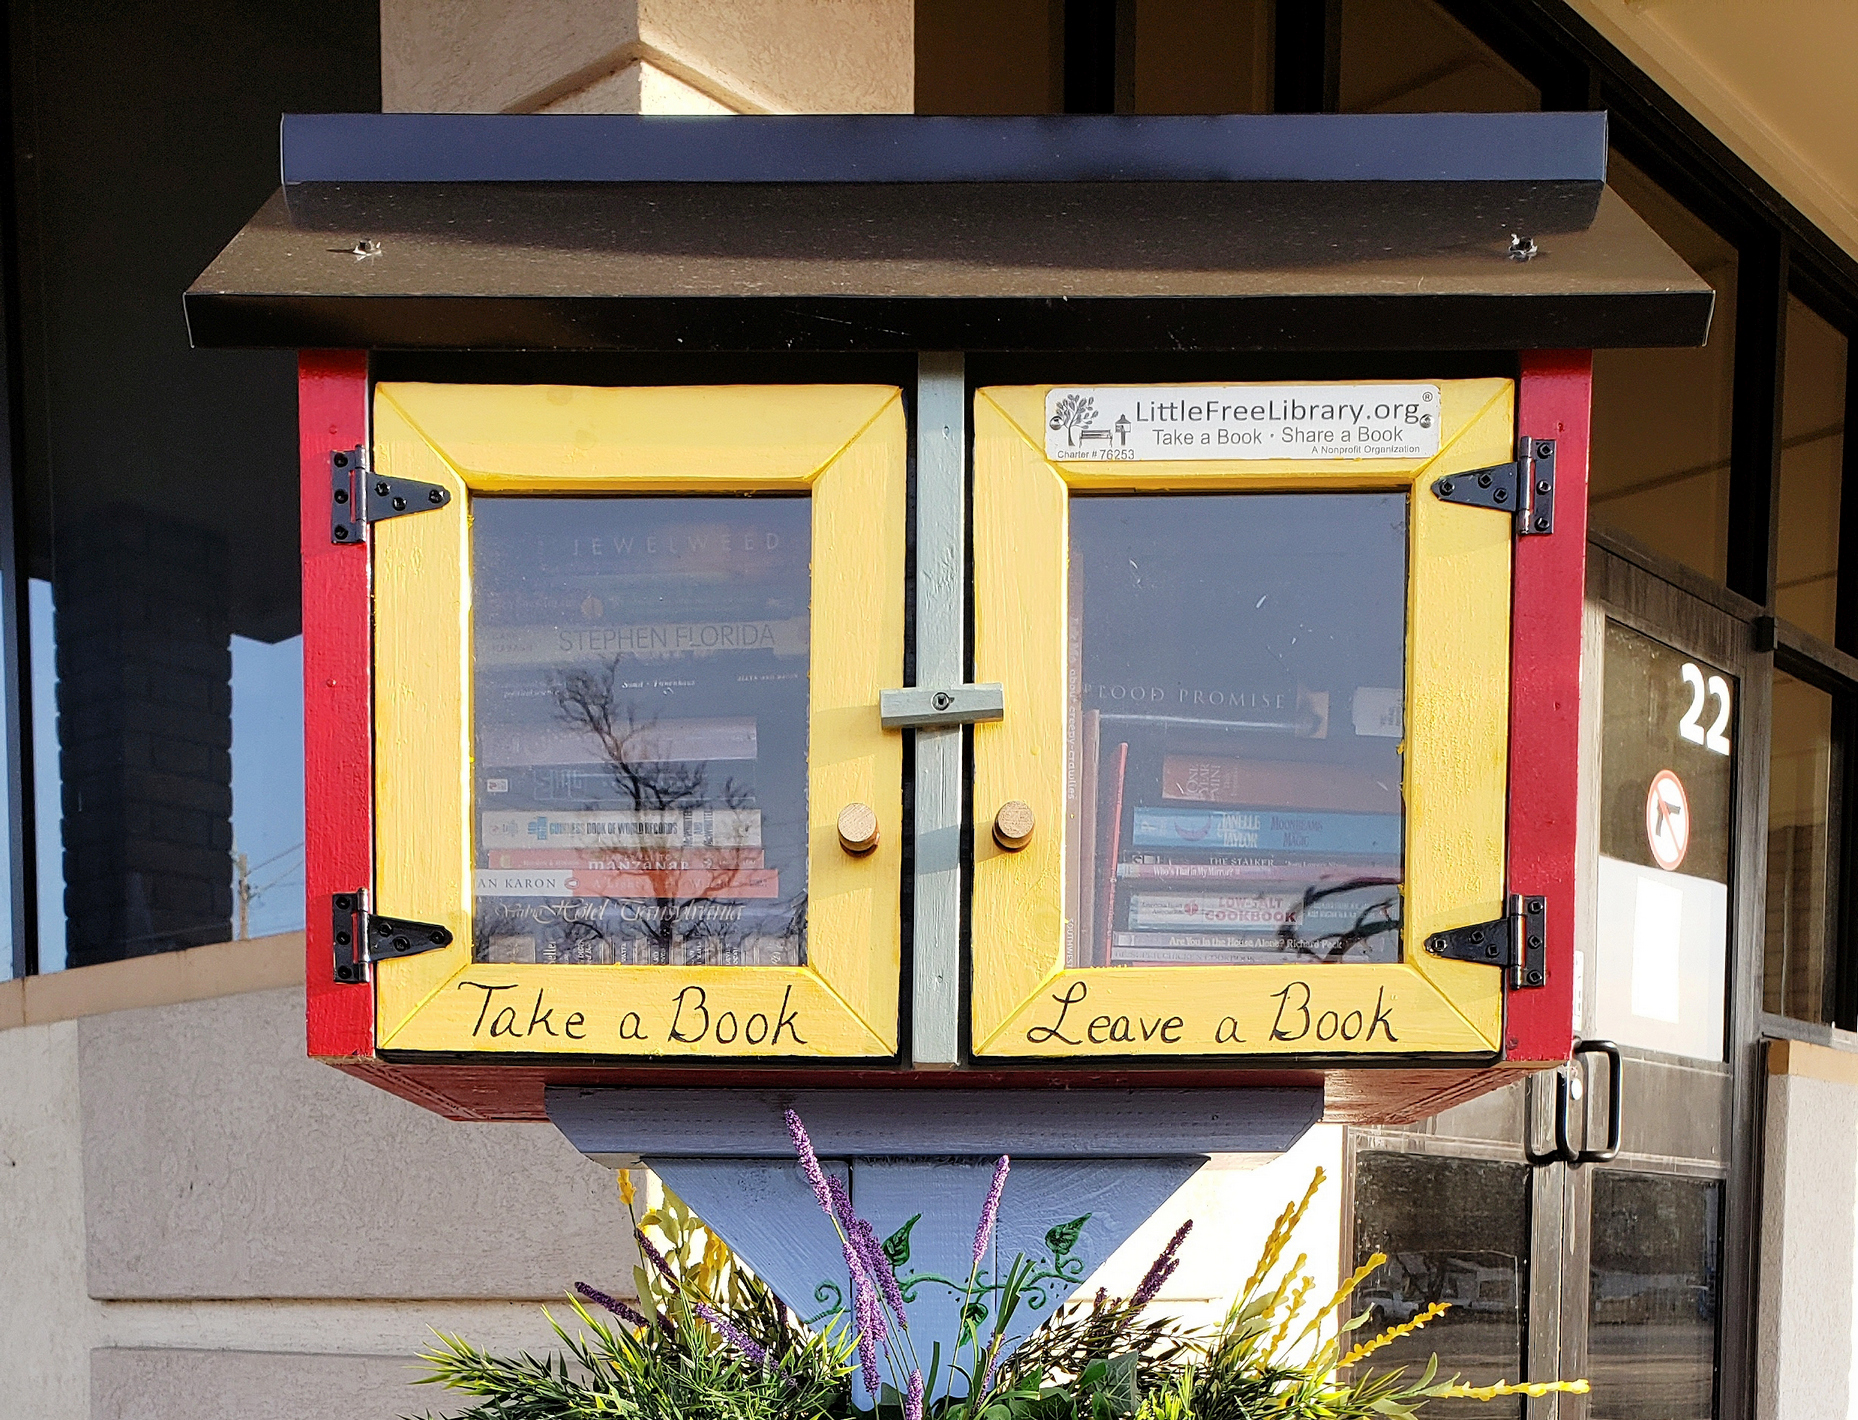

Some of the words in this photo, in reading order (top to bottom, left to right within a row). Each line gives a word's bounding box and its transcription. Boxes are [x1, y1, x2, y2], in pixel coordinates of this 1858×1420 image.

[1136, 399, 1420, 426] LittleFreeLibrary.org
[1152, 428, 1194, 445] Take
[1200, 432, 1211, 445] a
[1217, 428, 1263, 445] Book
[1281, 427, 1334, 443] Share
[1340, 431, 1351, 443] a
[1357, 426, 1404, 442] Book
[1057, 449, 1090, 460] Charter
[1099, 448, 1135, 460] 76253
[1311, 445, 1320, 454] A
[1321, 445, 1362, 455] Nonprofit
[1363, 444, 1420, 455] Organization
[572, 532, 780, 556] JEWELWEED
[559, 628, 668, 652] STEPHEN
[675, 622, 776, 649] FLORIDA
[1068, 668, 1077, 704] about
[1179, 687, 1286, 710] PROMISE
[1679, 661, 1731, 756] 22
[1067, 705, 1077, 800] creepy-crawlies
[1198, 763, 1210, 794] YEAR
[586, 821, 606, 835] BOOK
[607, 821, 617, 835] OF
[617, 821, 645, 836] WORLD
[644, 821, 678, 835] RECORDS
[1217, 812, 1261, 831] JANELLE
[1217, 831, 1258, 848] TAYLOR
[1283, 832, 1309, 848] MAGIC
[1231, 857, 1274, 867] STALKER
[1153, 865, 1174, 877] Who's
[1174, 866, 1190, 877] That
[1207, 866, 1234, 879] Mirror?
[477, 877, 498, 890] AN
[504, 877, 557, 890] KARON
[1204, 909, 1297, 924] COOKBOOK
[1169, 937, 1185, 947] Are
[1185, 937, 1201, 947] You
[1211, 937, 1226, 948] the
[1227, 938, 1254, 949] House
[1254, 938, 1285, 950] Alone?
[1286, 938, 1319, 950] Richard
[457, 981, 587, 1038] Take
[619, 1011, 648, 1041] a
[667, 984, 808, 1046] Book
[1026, 980, 1185, 1046] Leave
[1214, 1015, 1247, 1043] a
[1269, 981, 1399, 1043] Book
